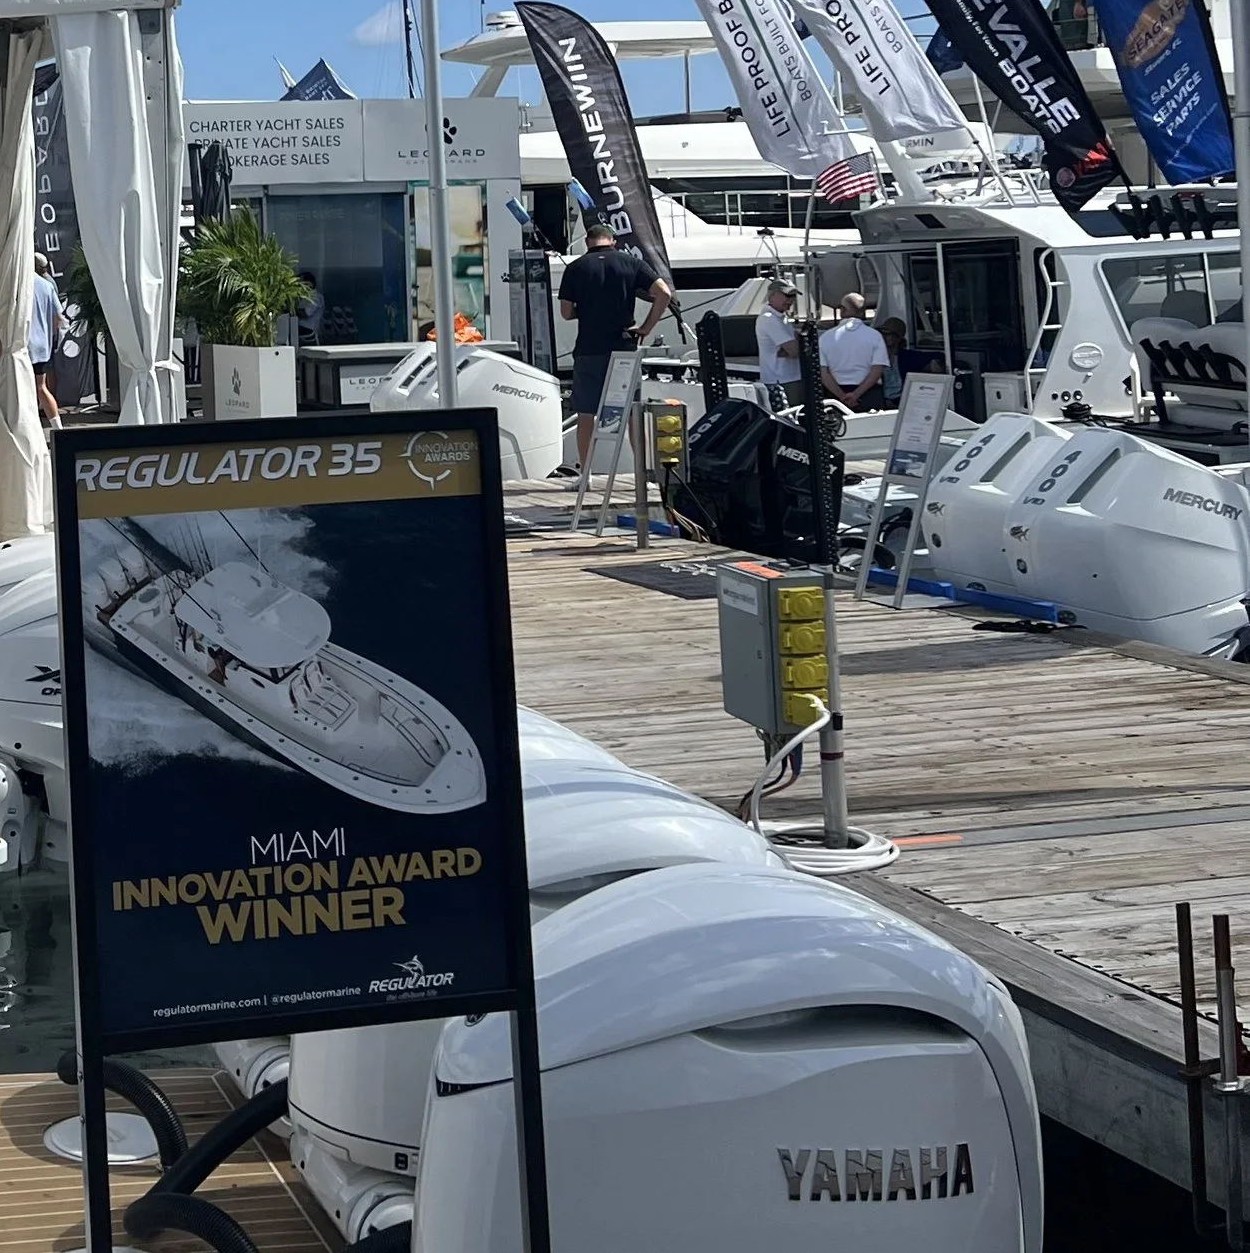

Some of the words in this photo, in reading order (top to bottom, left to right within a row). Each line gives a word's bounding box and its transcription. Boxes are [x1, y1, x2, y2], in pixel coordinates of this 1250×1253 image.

[764, 15, 791, 55] BUILT
[871, 7, 902, 53] BOATS
[726, 19, 770, 90] PROOF
[856, 45, 891, 96] LIFE
[784, 54, 811, 101] BOATS
[998, 59, 1060, 134] BOATS
[1151, 62, 1190, 105] SALES
[1153, 70, 1202, 127] SERVICE
[190, 120, 251, 132] CHARTER
[255, 119, 301, 131] YACHT
[305, 118, 344, 130] SALES
[760, 88, 790, 137] LIFE
[1166, 92, 1201, 136] PARTS
[253, 136, 298, 148] YACHT
[302, 135, 341, 147] SALES
[398, 149, 485, 158] LEOARD
[558, 37, 632, 236] BURNEWIIN
[228, 154, 287, 167] OKERAGE
[291, 153, 330, 165] SALES
[491, 383, 548, 403] MERCURY
[75, 444, 321, 491] REGULATOR
[327, 441, 382, 477] 35
[414, 441, 478, 453] INNOVATION
[424, 451, 471, 462] AWARDS
[954, 433, 996, 472] 400
[1038, 450, 1082, 492] 400
[1162, 487, 1243, 520] MERCURY
[251, 827, 346, 865] MIAMI
[112, 860, 339, 911] INNOVATION
[347, 847, 482, 888] AWARD
[195, 886, 406, 945] WINNER
[153, 996, 261, 1018] regulatormarine.com
[272, 986, 361, 1005] @regulatormarine
[368, 973, 454, 994] REGULATOR
[776, 1143, 974, 1201] YAMAHA
